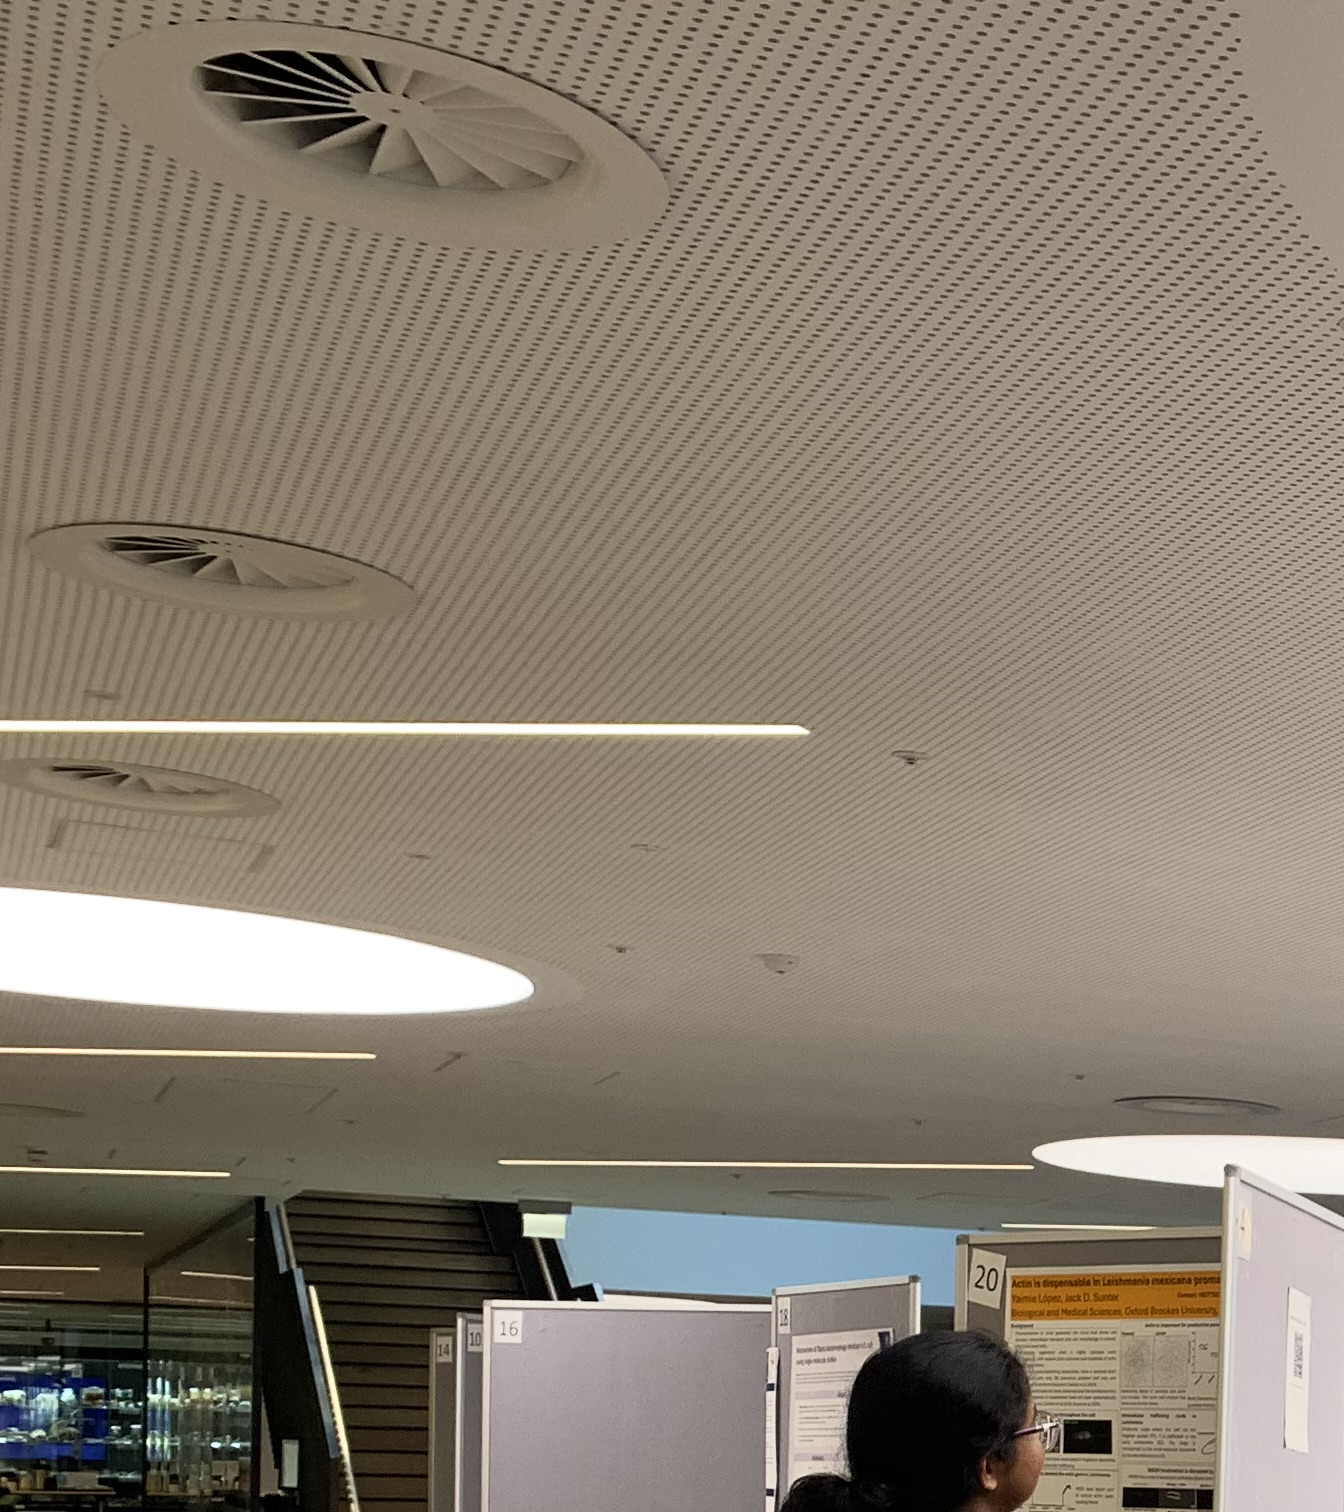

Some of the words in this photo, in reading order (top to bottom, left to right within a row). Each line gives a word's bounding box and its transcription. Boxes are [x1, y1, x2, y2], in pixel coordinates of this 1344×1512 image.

[974, 1265, 999, 1292] 20
[1011, 1279, 1032, 1288] Actin
[1042, 1277, 1091, 1289] dispensable
[1092, 1277, 1101, 1286] in
[1102, 1275, 1150, 1286] Leishmania
[1151, 1276, 1192, 1285] mexicana
[780, 1309, 789, 1326] 18
[500, 1321, 519, 1337] 16
[469, 1332, 481, 1346] 10
[438, 1344, 450, 1357] 14
